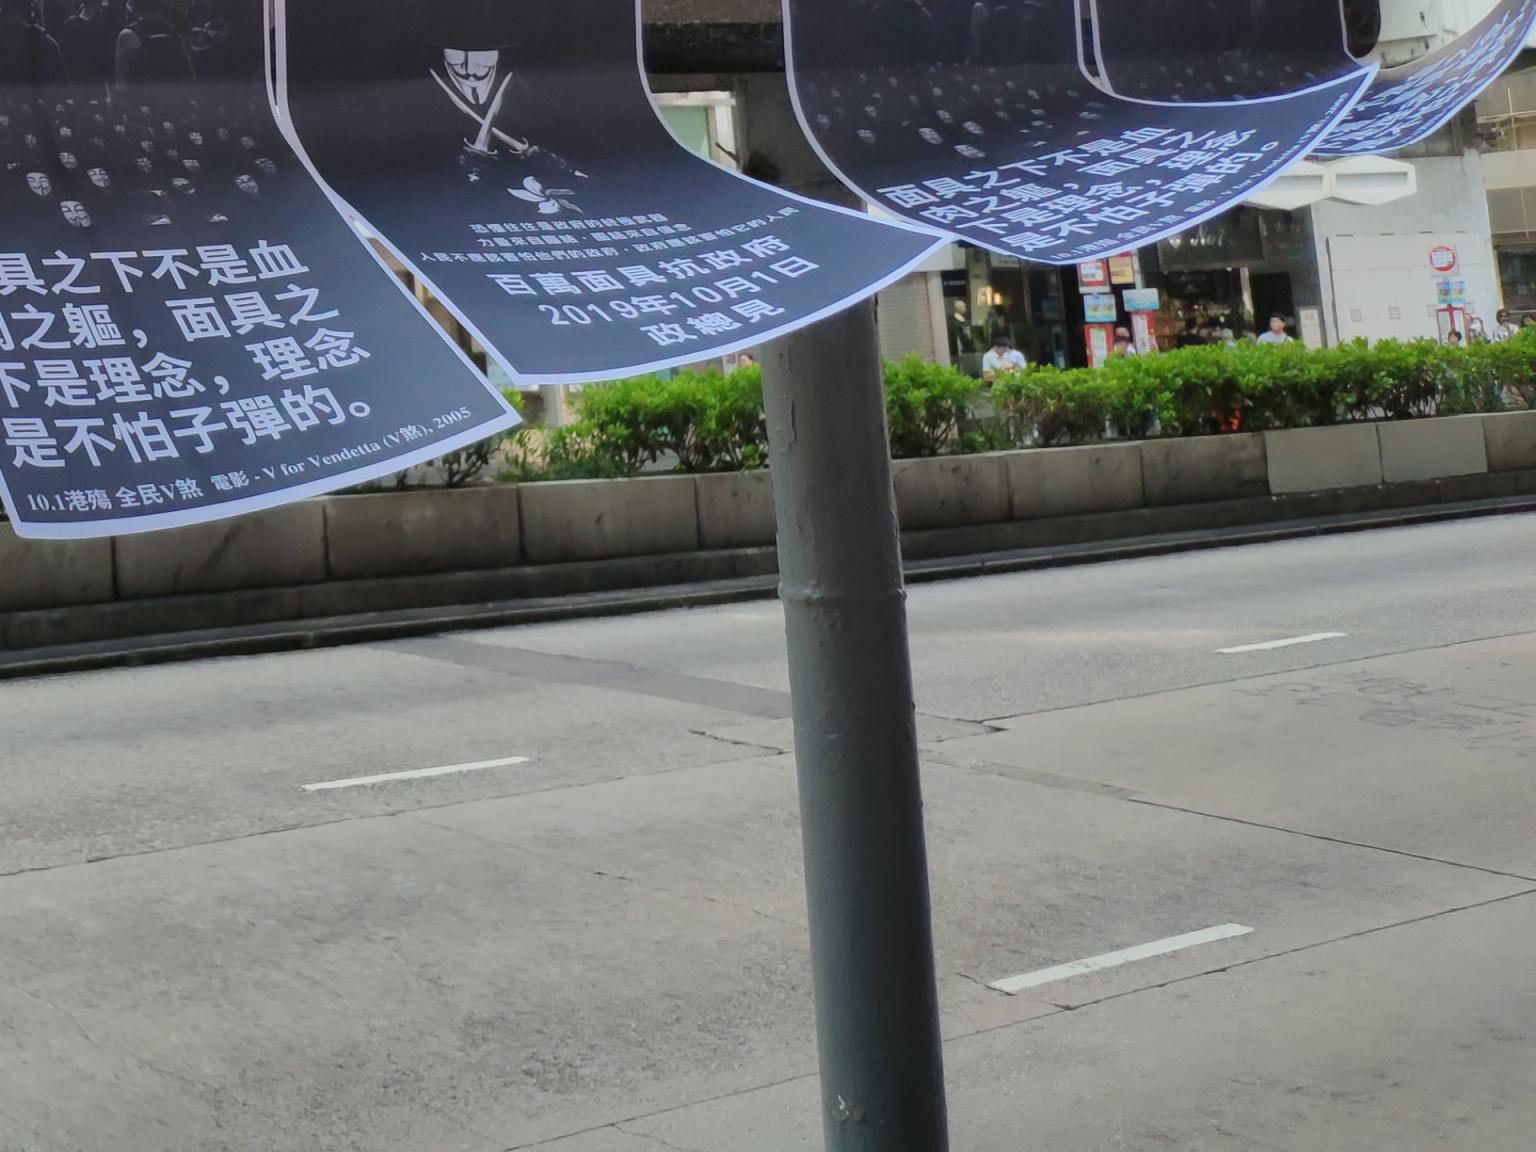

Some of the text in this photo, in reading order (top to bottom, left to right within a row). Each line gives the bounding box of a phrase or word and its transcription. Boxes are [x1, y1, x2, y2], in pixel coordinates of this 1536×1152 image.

[876, 124, 1176, 209] 面具之下不是血
[486, 234, 792, 296] 百萬面具抗政府
[538, 254, 821, 327] 2019年10月1日
[639, 298, 787, 348] 政總見
[1, 384, 372, 469] 是不怕子彈的。
[210, 470, 250, 492] 電影
[262, 465, 278, 481] V
[279, 458, 306, 477] for
[309, 442, 382, 468] Vendetta
[435, 406, 472, 430] 2005
